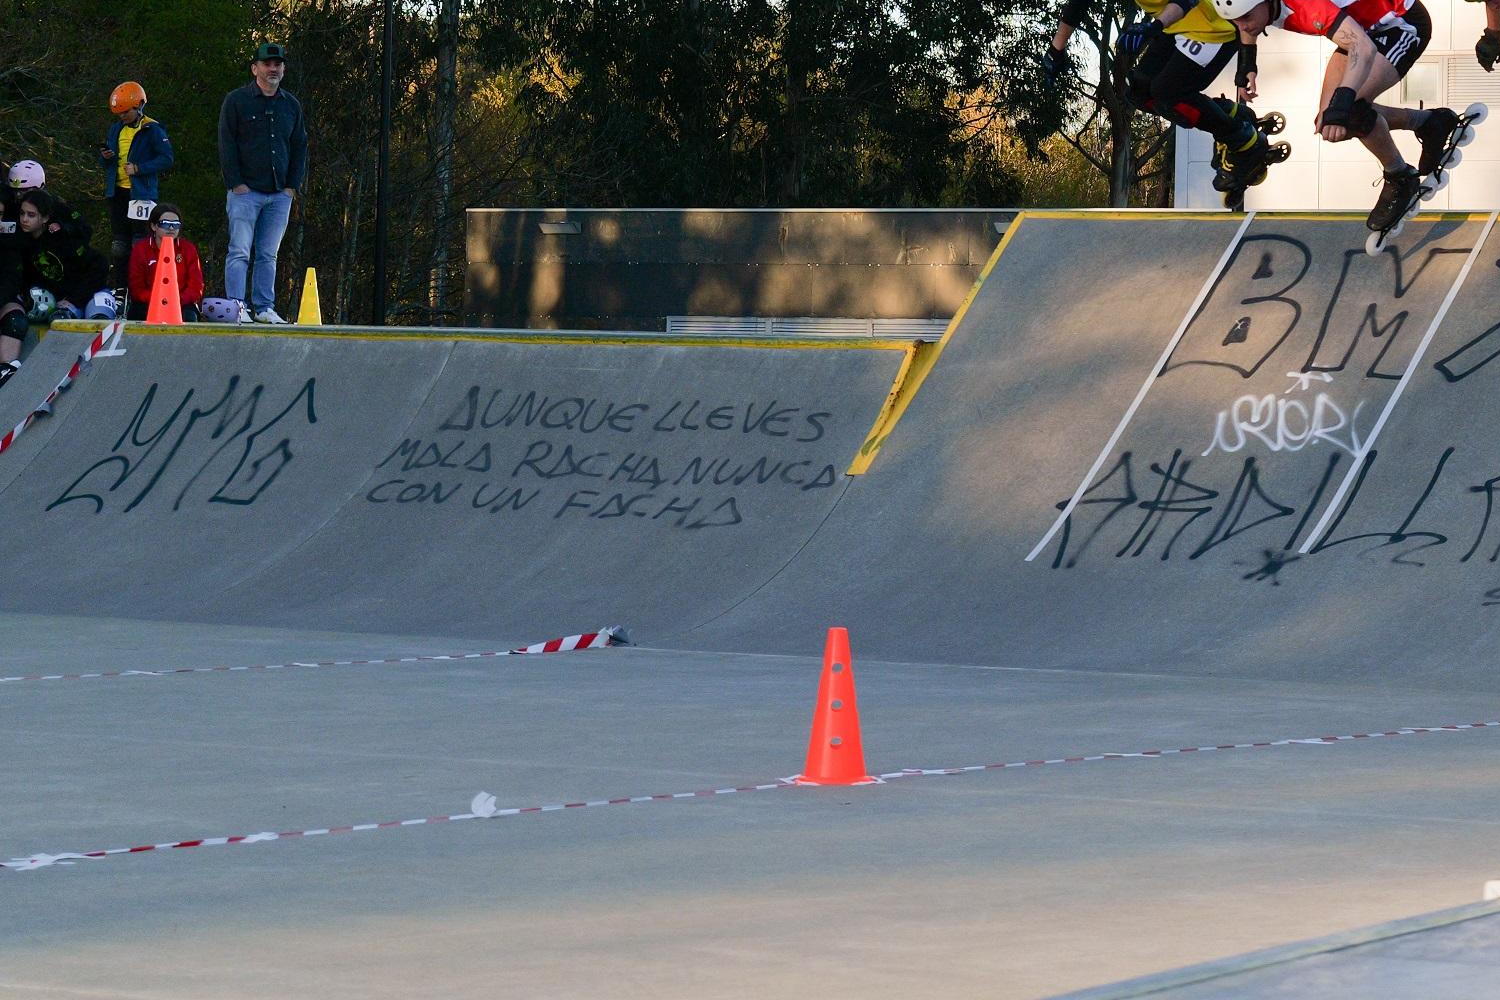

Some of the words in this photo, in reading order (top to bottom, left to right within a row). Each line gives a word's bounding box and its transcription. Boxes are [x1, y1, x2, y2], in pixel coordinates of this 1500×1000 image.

[136, 206, 150, 218] 81
[438, 386, 649, 435] AUNQUE
[655, 399, 834, 442] LLEVES
[375, 439, 492, 473] MALA
[513, 440, 668, 489] RACHA
[677, 453, 838, 491] NUNCA
[366, 480, 463, 503] CON
[471, 485, 540, 513] UN
[555, 488, 744, 529] FACHA
